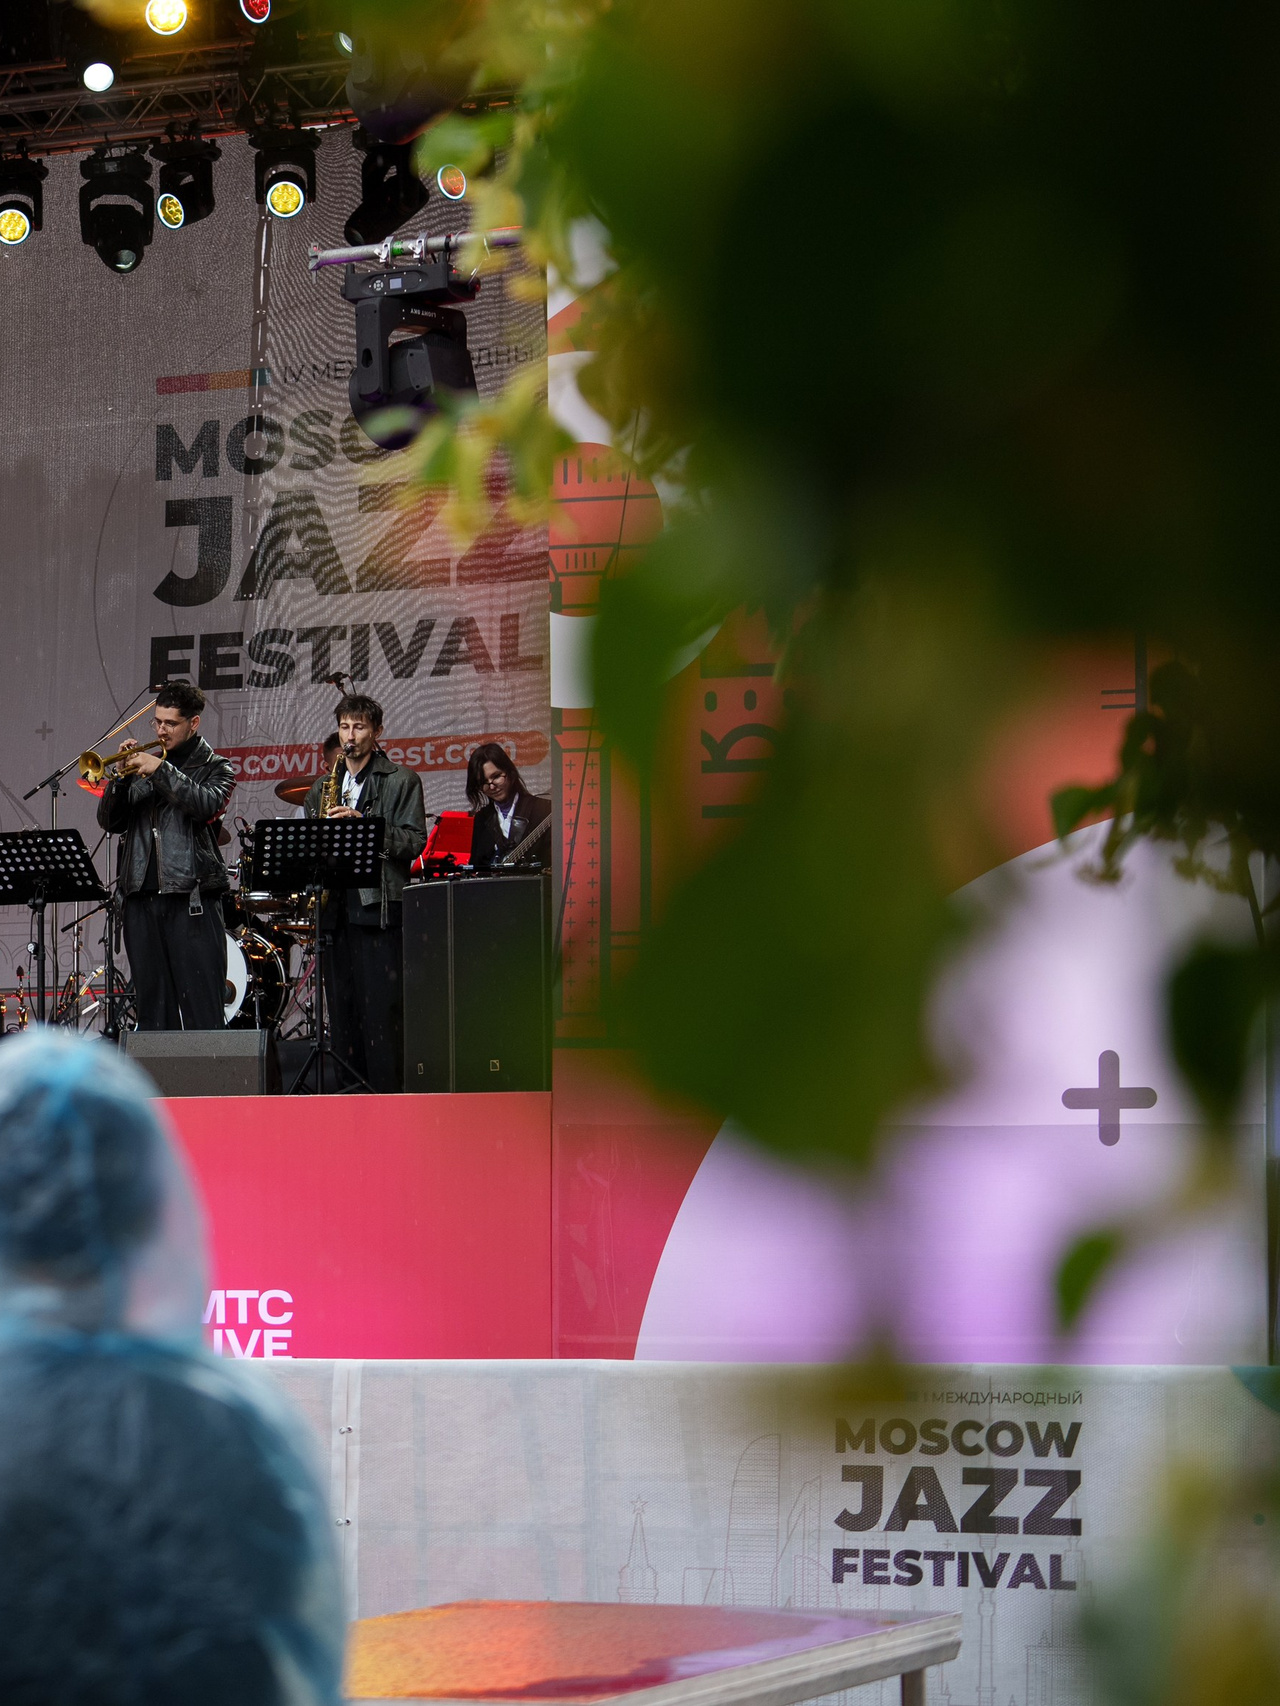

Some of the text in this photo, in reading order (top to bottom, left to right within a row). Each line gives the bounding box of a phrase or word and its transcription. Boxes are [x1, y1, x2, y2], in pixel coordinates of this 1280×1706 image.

[149, 613, 544, 694] FESTIVAL
[213, 1329, 293, 1359] IVE
[932, 1390, 1083, 1406] МЕЖДУНАРОДНЫЙ
[835, 1418, 1083, 1458] MOSCOW
[834, 1464, 1083, 1536] JAZZ
[832, 1548, 1077, 1591] FESTIVAL
